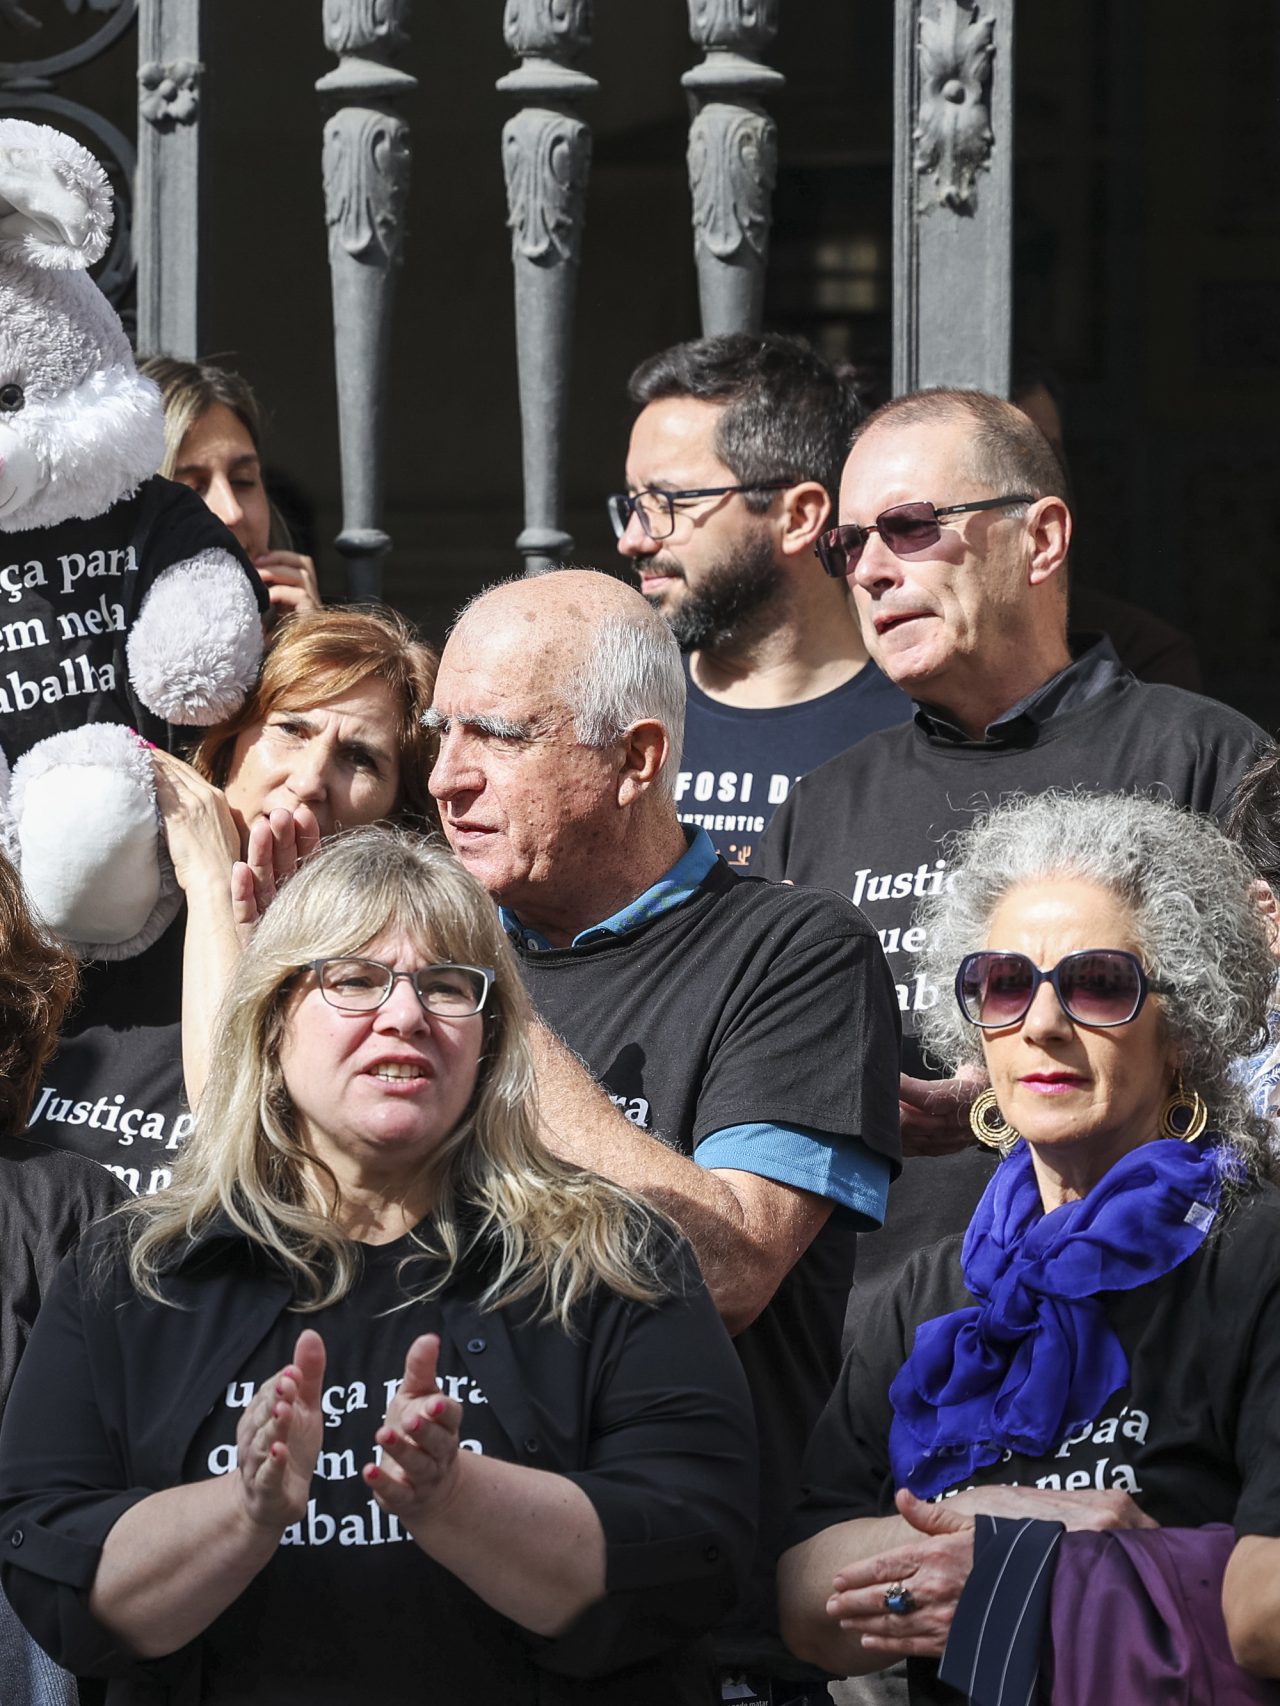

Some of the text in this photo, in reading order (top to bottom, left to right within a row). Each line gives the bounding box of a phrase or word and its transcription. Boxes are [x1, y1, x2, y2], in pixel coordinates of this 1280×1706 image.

[57, 545, 139, 594] para
[56, 593, 127, 640] nela
[767, 774, 804, 804] D
[24, 1087, 165, 1146] Justiça
[1054, 1406, 1149, 1458] paa
[1035, 1457, 1143, 1494] nela
